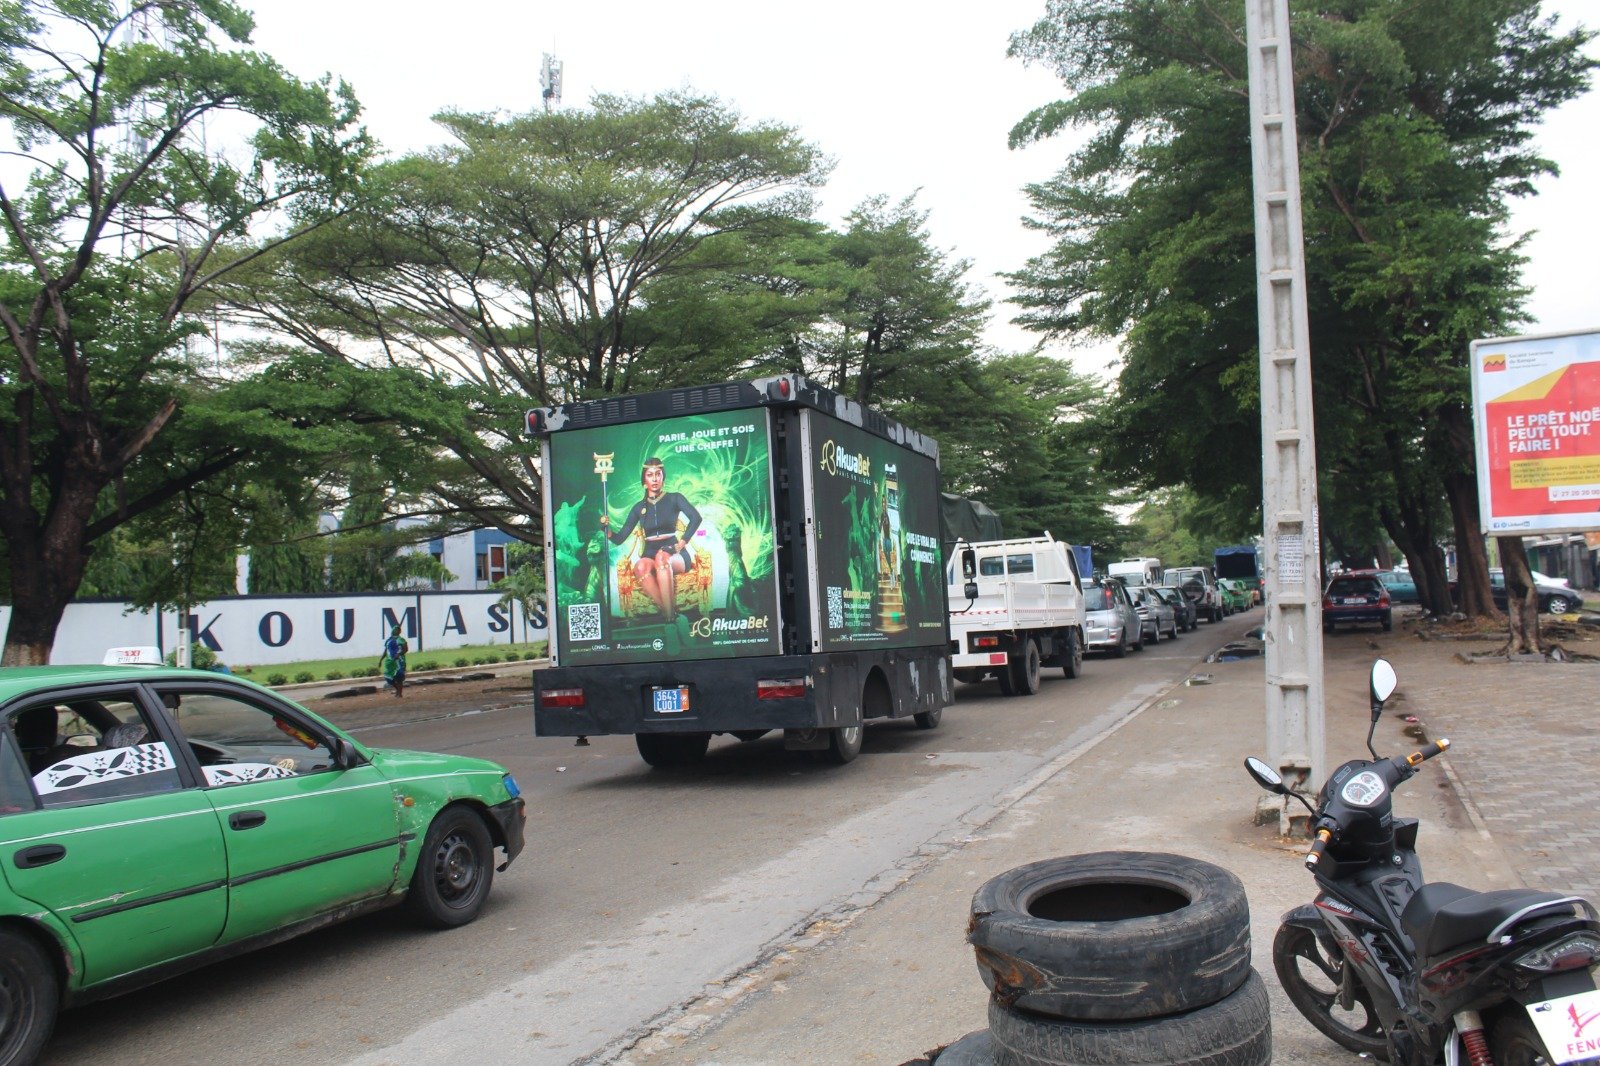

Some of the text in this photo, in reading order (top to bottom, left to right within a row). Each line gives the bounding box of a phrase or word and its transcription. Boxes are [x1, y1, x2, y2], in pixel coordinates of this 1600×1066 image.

[1507, 415, 1524, 428] LE
[1528, 410, 1566, 426] PRÊT
[691, 429, 716, 439] JOUE
[718, 428, 729, 436] ET
[732, 424, 755, 434] SOIS
[1508, 423, 1590, 441] PEUT TOUT
[675, 444, 695, 453] UNE
[697, 439, 734, 450] CHEFFE
[1508, 439, 1551, 453] FAIRE
[836, 445, 870, 477] AkwaBet
[712, 615, 769, 632] AkwaBet
[656, 691, 677, 701] 3643
[1566, 1038, 1600, 1056] FEN
